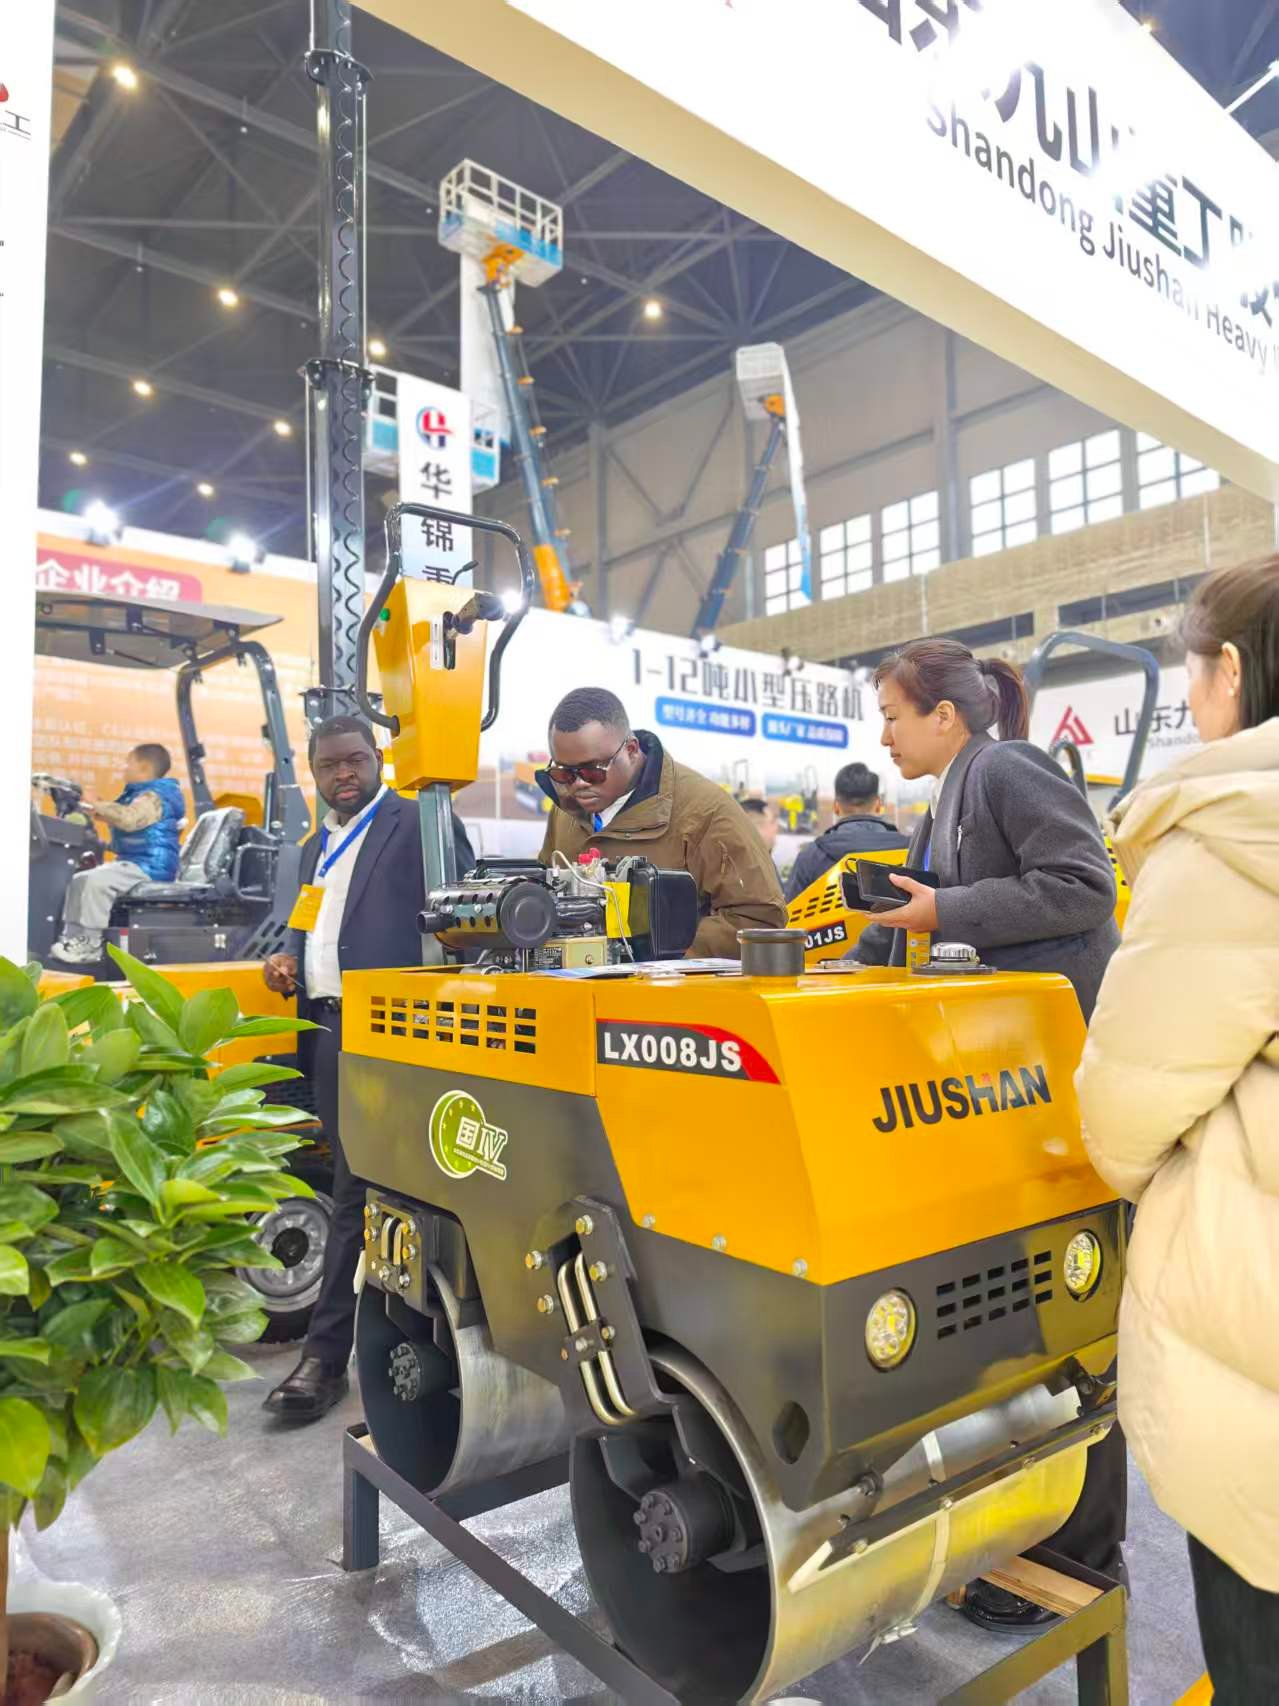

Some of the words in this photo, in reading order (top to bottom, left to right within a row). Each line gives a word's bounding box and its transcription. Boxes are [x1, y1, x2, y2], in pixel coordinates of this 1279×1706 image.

[925, 97, 1096, 257] Shandong
[36, 559, 180, 600] 企业介绍
[604, 1032, 742, 1072] LX008JS
[872, 1063, 1052, 1133] JIUSHAN
